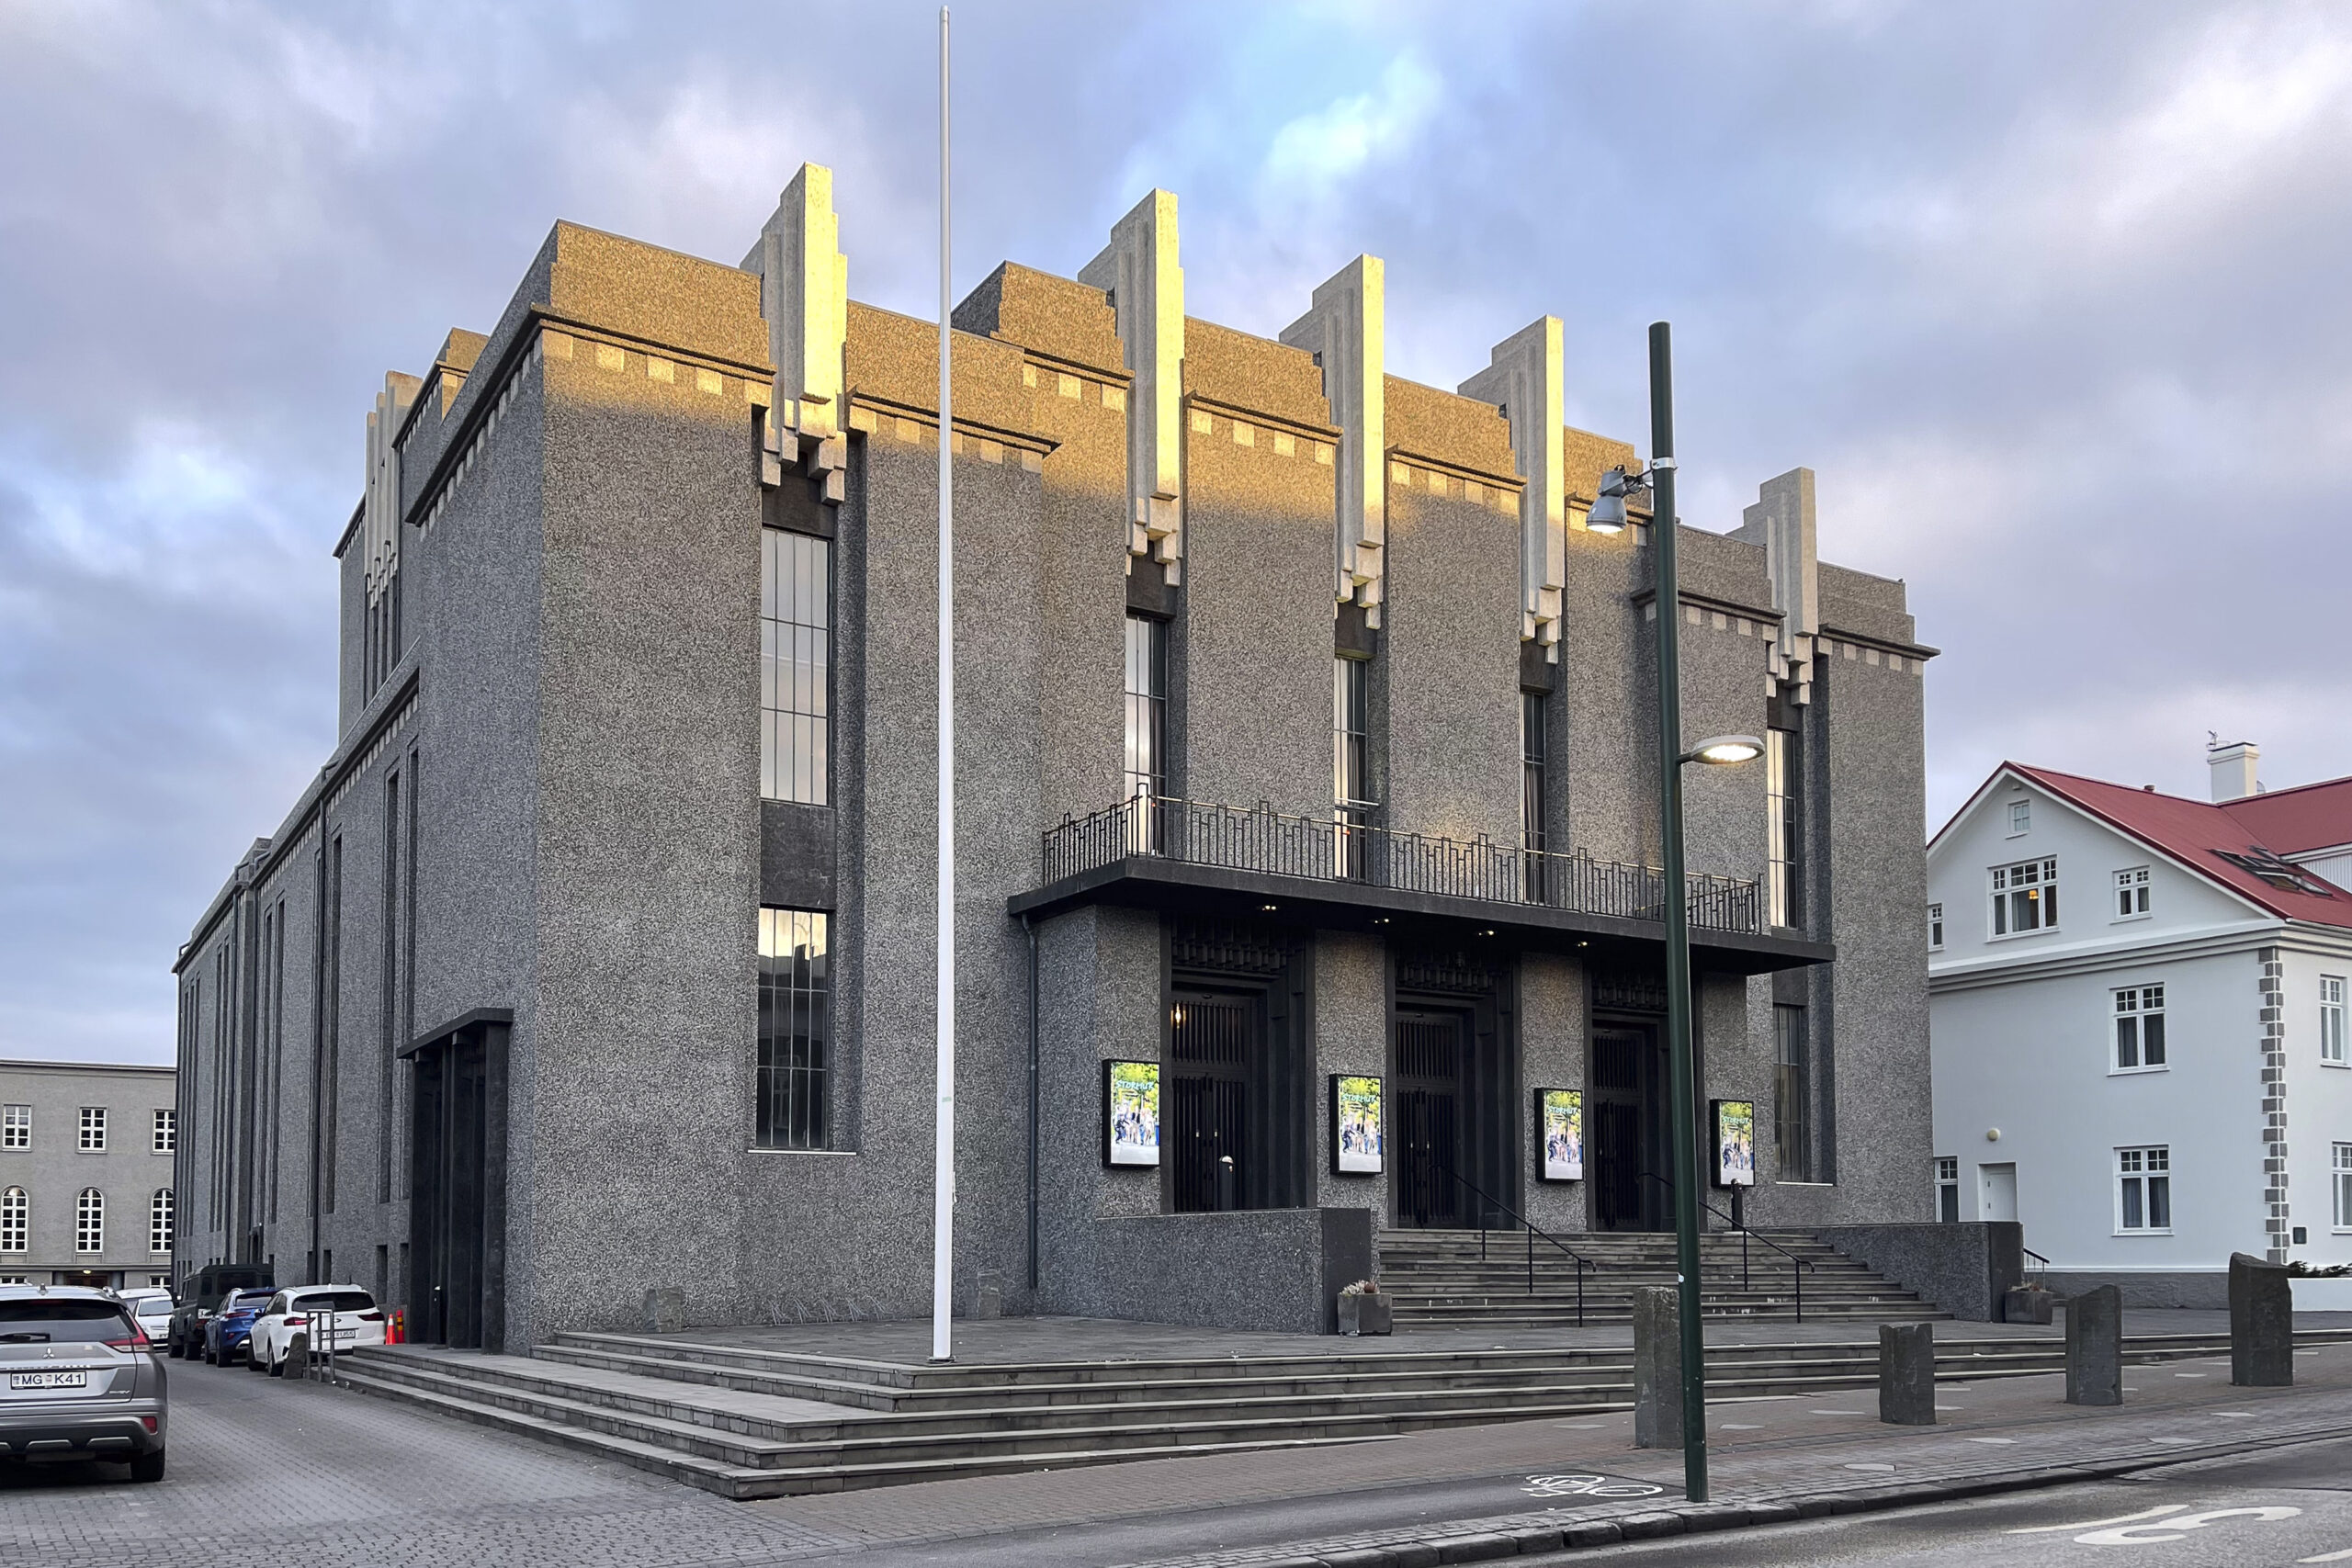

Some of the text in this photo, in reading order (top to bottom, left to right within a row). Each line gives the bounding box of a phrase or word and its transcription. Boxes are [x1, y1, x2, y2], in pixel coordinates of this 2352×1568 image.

[1115, 1080, 1155, 1090] STORMUR
[21, 1373, 83, 1385] MG K41
